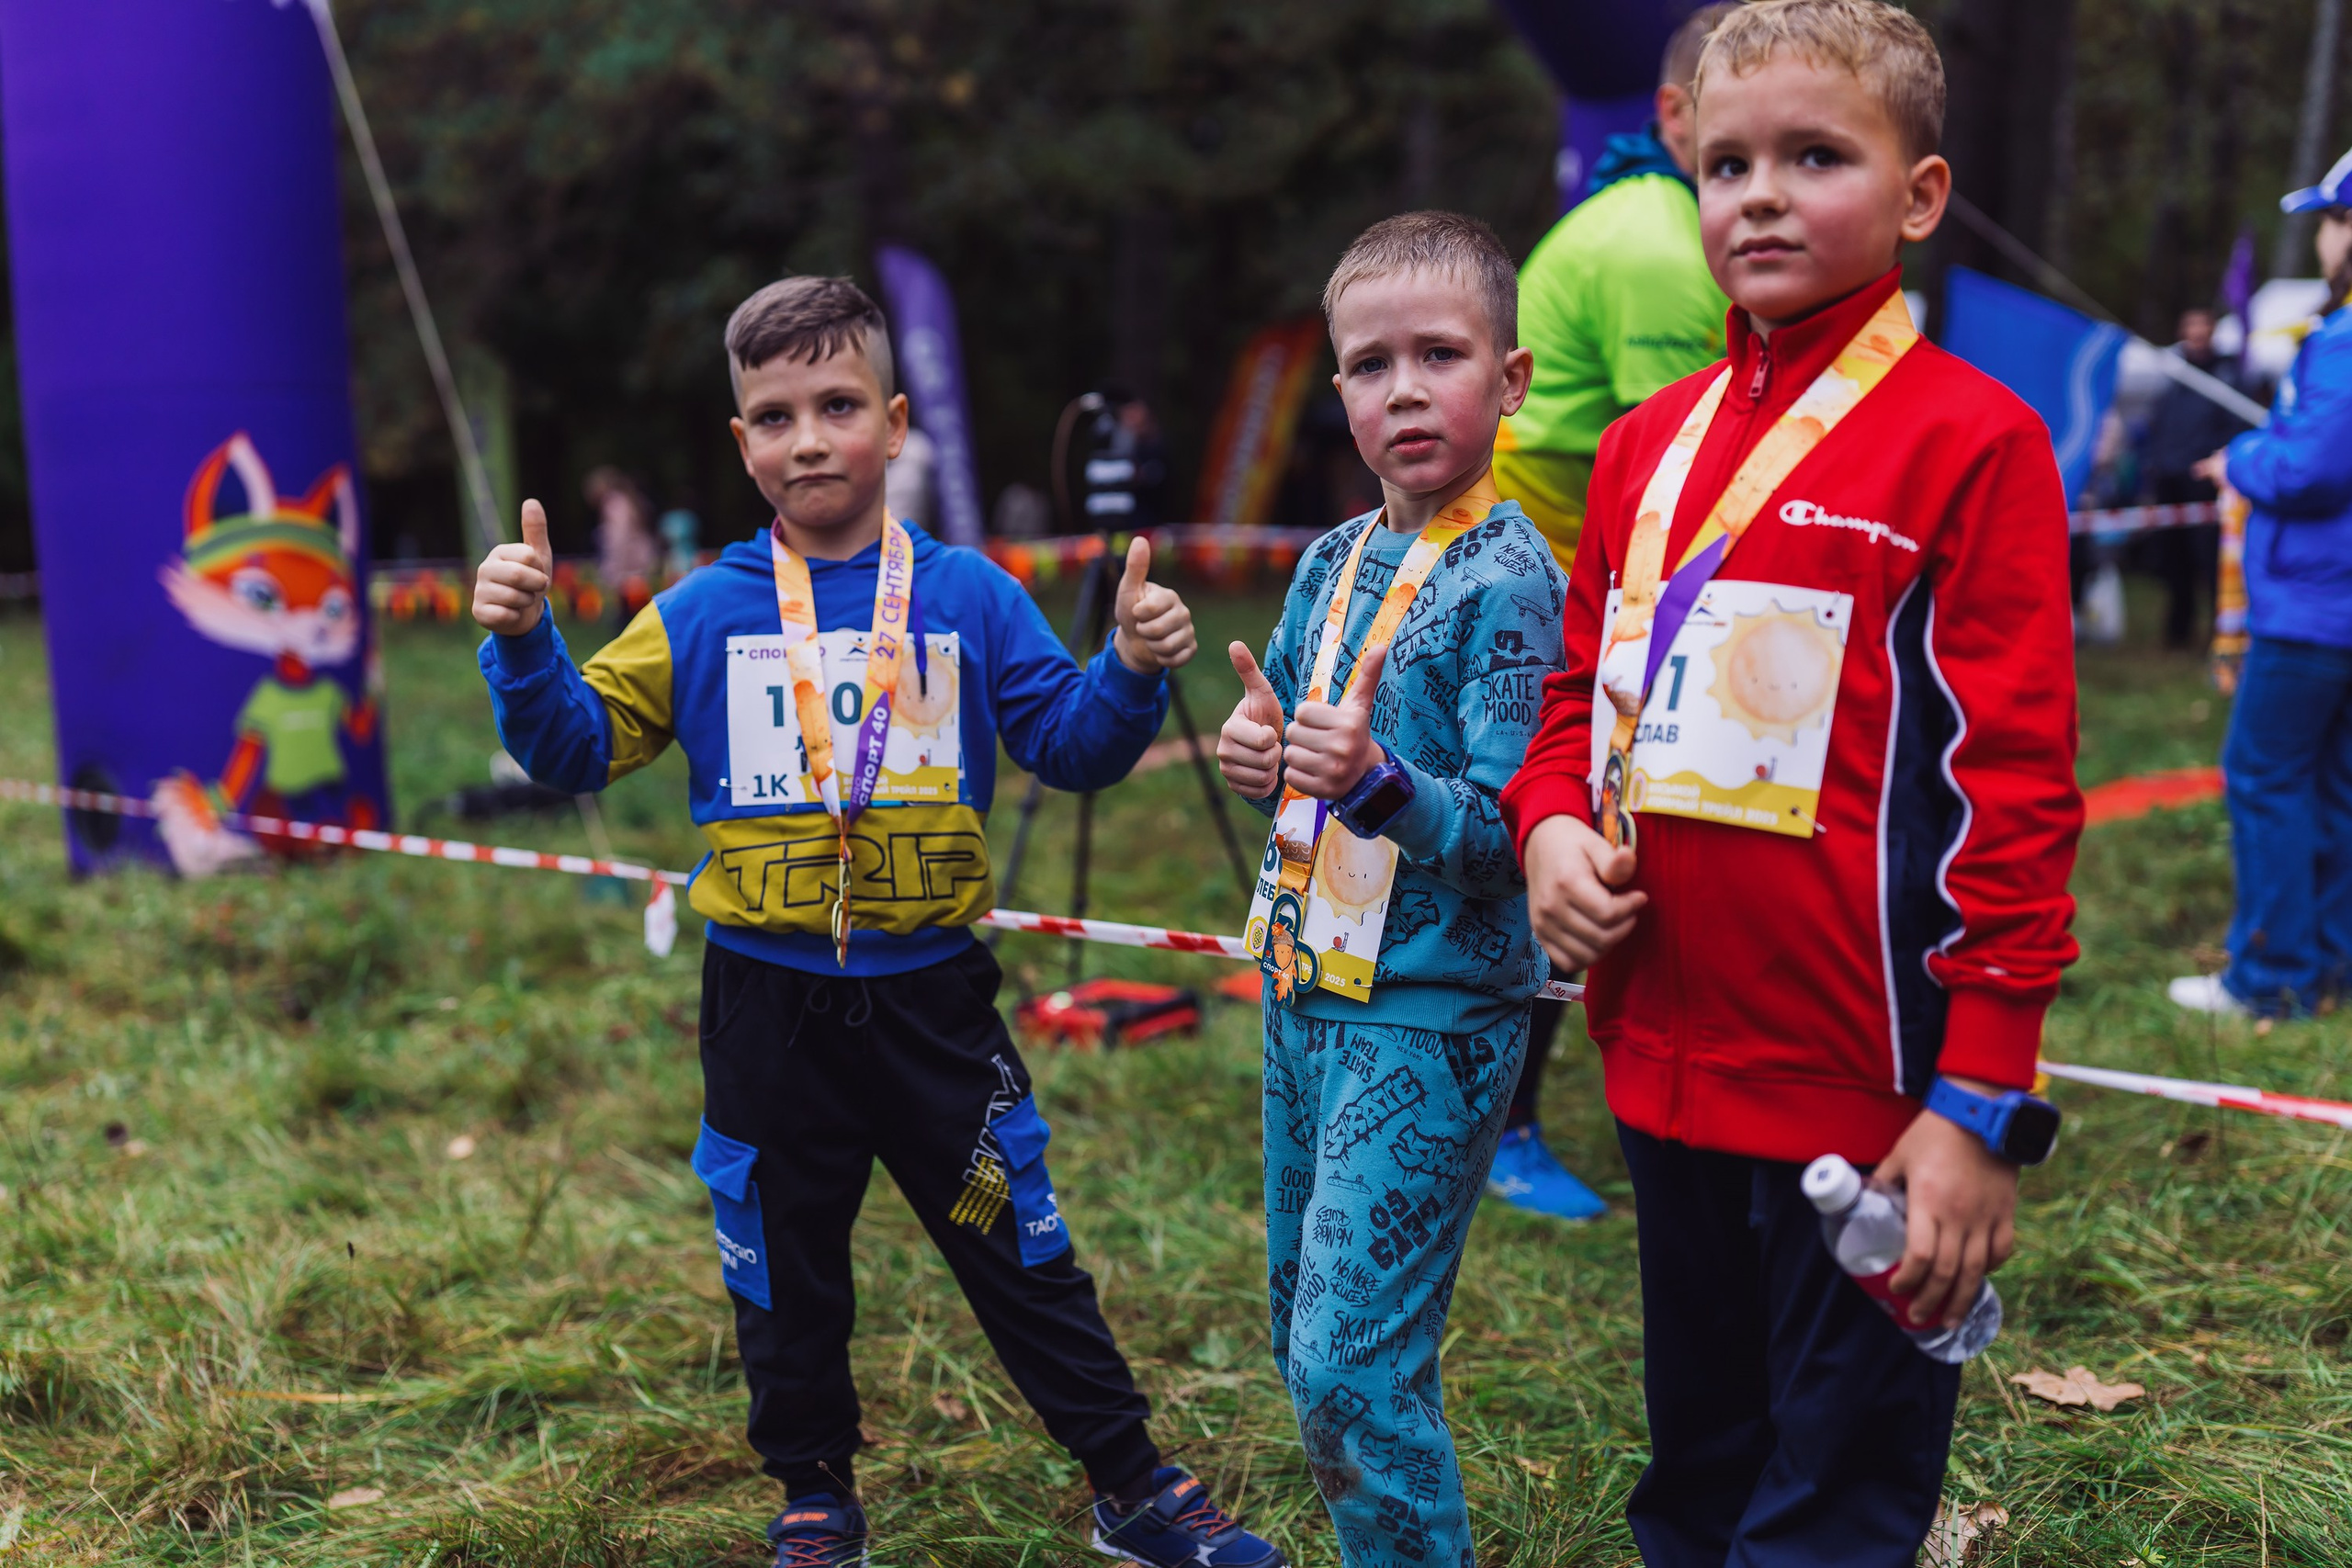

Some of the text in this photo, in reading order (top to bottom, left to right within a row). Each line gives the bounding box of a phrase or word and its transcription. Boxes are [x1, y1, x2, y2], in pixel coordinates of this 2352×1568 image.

[1445, 542, 1482, 569] GO
[875, 631, 898, 660] 27
[1423, 680, 1451, 715] TEAM
[1480, 673, 1534, 701] SKATE
[766, 682, 864, 728] 10
[1485, 700, 1532, 726] MOOD
[1633, 722, 1679, 743] СЛАВ
[859, 735, 883, 807] СПОРТ
[872, 706, 888, 732] 40
[1263, 821, 1283, 873] 8
[720, 831, 990, 912] TRIP
[1262, 960, 1290, 980] СПОРТ 40
[1324, 972, 1347, 987] 2025
[1555, 987, 1566, 998] 40
[1350, 1032, 1380, 1063] TEAM
[1401, 1027, 1443, 1060] MOOD
[1338, 1050, 1375, 1084] SKATE
[1281, 1166, 1316, 1190] OOD
[1336, 1228, 1353, 1249] NO
[1332, 1256, 1351, 1279] NO
[1295, 1273, 1326, 1320] MOOD
[1329, 1310, 1389, 1346] SKATE
[1329, 1339, 1377, 1369] MOOD
[1415, 1448, 1446, 1510] SKATE
